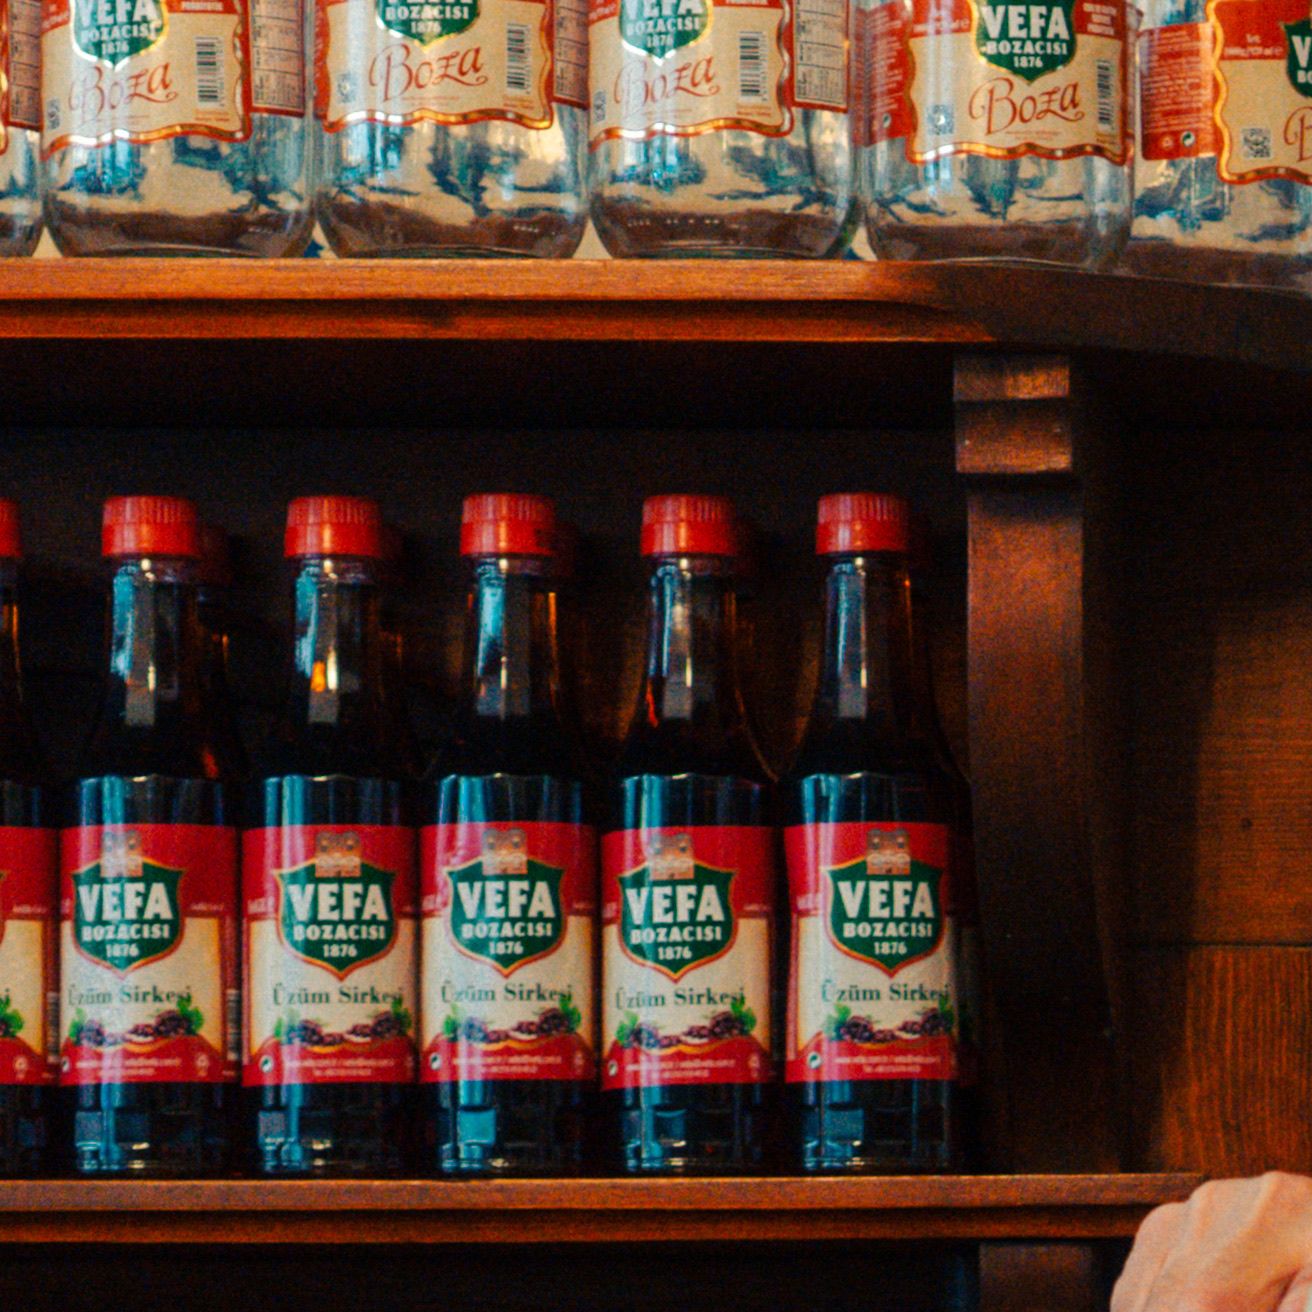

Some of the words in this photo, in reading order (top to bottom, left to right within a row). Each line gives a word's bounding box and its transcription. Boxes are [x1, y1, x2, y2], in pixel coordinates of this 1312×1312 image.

[79, 0, 158, 25] VEFA
[384, 5, 469, 21] BOZACISI
[411, 21, 441, 34] 1876
[626, 16, 701, 36] BOZACISI
[981, 5, 1070, 40] VEFA
[646, 34, 673, 48] 1876
[985, 41, 1068, 56] BOZACISI
[1013, 56, 1043, 68] 1876
[369, 43, 488, 101] Boza
[69, 62, 178, 122] Boza
[614, 56, 720, 116] Boza
[969, 76, 1085, 136] Boza
[77, 882, 174, 922] VEFA
[287, 883, 388, 922] VEFA
[457, 880, 555, 919] VEFA
[625, 885, 725, 925] VEFA
[837, 880, 935, 919] VEFA
[81, 923, 170, 942] BOZACISI
[293, 924, 385, 941] BOZACISI
[461, 921, 552, 939] BOZACISI
[630, 926, 722, 945] BOZACISI
[843, 922, 932, 938] BOZACISI
[106, 943, 140, 957] 1876
[323, 944, 357, 958] 1876
[489, 941, 523, 955] 1876
[658, 946, 692, 960] 1876
[874, 941, 908, 955] 1876
